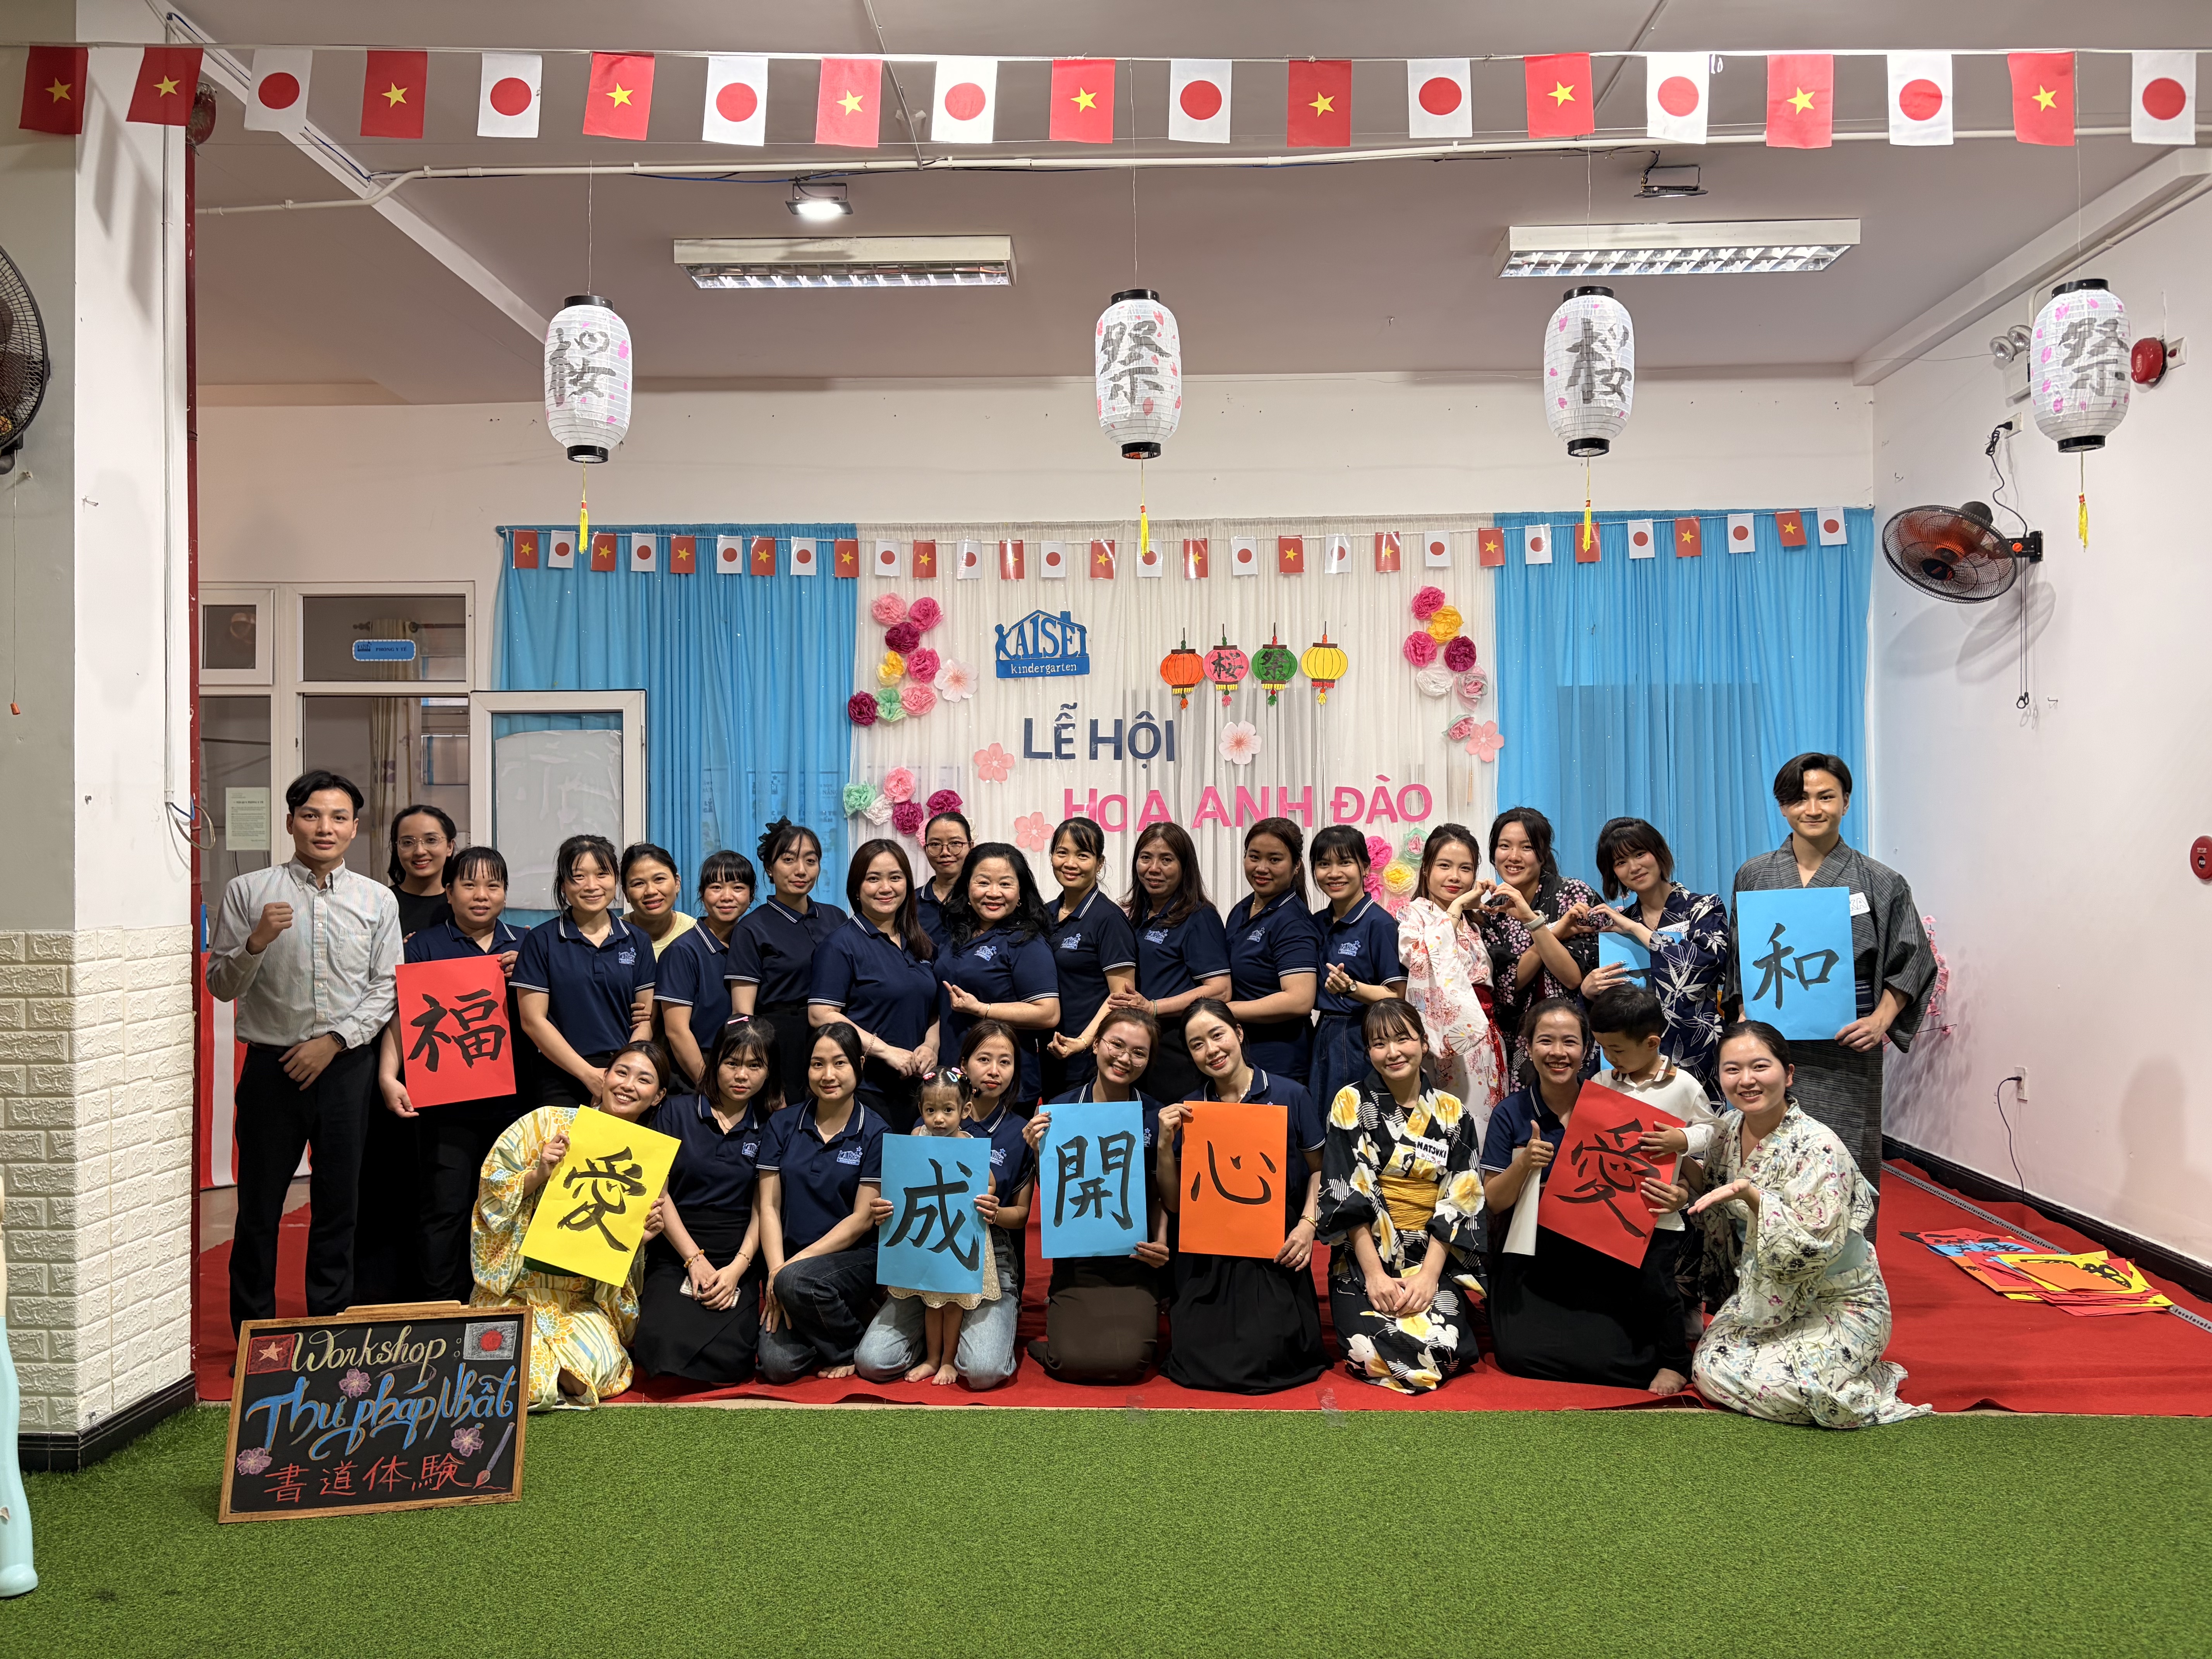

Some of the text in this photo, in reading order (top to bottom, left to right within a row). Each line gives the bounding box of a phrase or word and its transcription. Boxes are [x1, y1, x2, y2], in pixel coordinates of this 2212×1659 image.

[1099, 321, 1172, 412] 祭
[1565, 318, 1632, 404] 桜
[1011, 663, 1077, 675] kindergarten
[1211, 652, 1243, 679] 桜
[1260, 651, 1290, 680] 祭
[1024, 702, 1175, 769] LỄ HỘI
[1064, 775, 1432, 832] HOA ANH ĐÀO
[1752, 923, 1839, 1010] 和
[407, 989, 506, 1072] 福
[1053, 1130, 1136, 1230] 開
[1190, 1140, 1276, 1205] 心
[1417, 1141, 1446, 1158] NATSUKI
[1554, 1118, 1661, 1239] 愛
[557, 1146, 647, 1253] 愛
[884, 1158, 979, 1271] 成
[309, 1373, 436, 1460] pháp
[425, 1362, 517, 1441] Nhật
[264, 1453, 473, 1503] 書道体験
